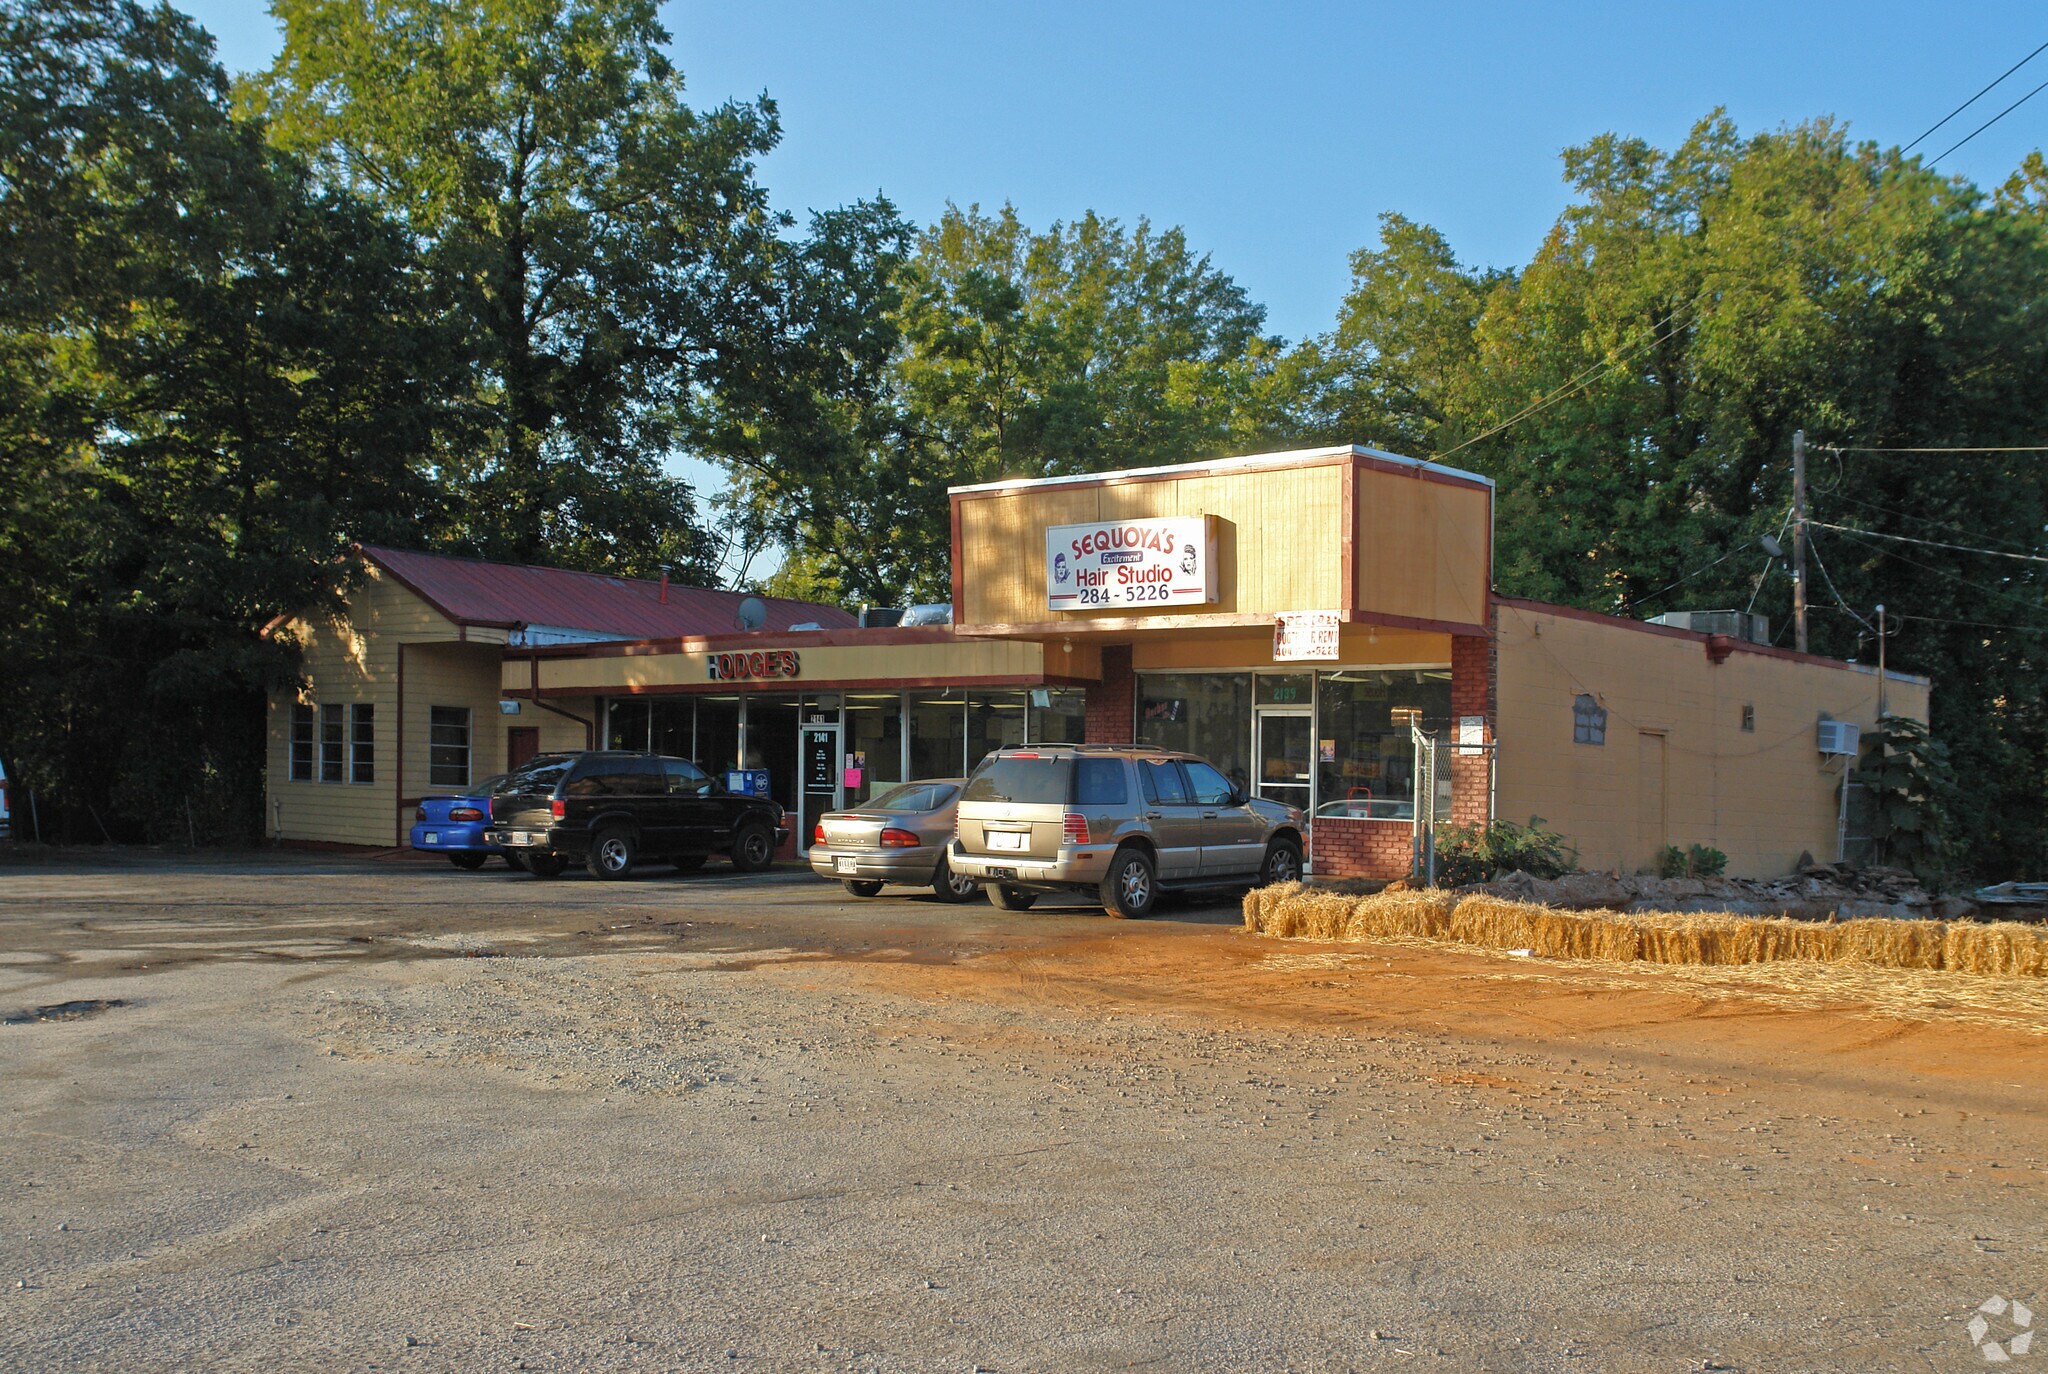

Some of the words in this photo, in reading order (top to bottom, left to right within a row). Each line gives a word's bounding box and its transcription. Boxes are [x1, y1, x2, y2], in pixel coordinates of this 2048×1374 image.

[1071, 526, 1174, 560] SEQUOYA'S
[1102, 553, 1142, 564] Excitement
[1076, 567, 1109, 587] Hair
[1117, 564, 1173, 585] Studio
[1080, 588, 1110, 604] 284
[1126, 584, 1169, 602] 5226
[706, 650, 800, 679] HODGE'S
[1274, 687, 1296, 701] 2139
[811, 715, 824, 723] 2141
[813, 732, 828, 743] 2141
